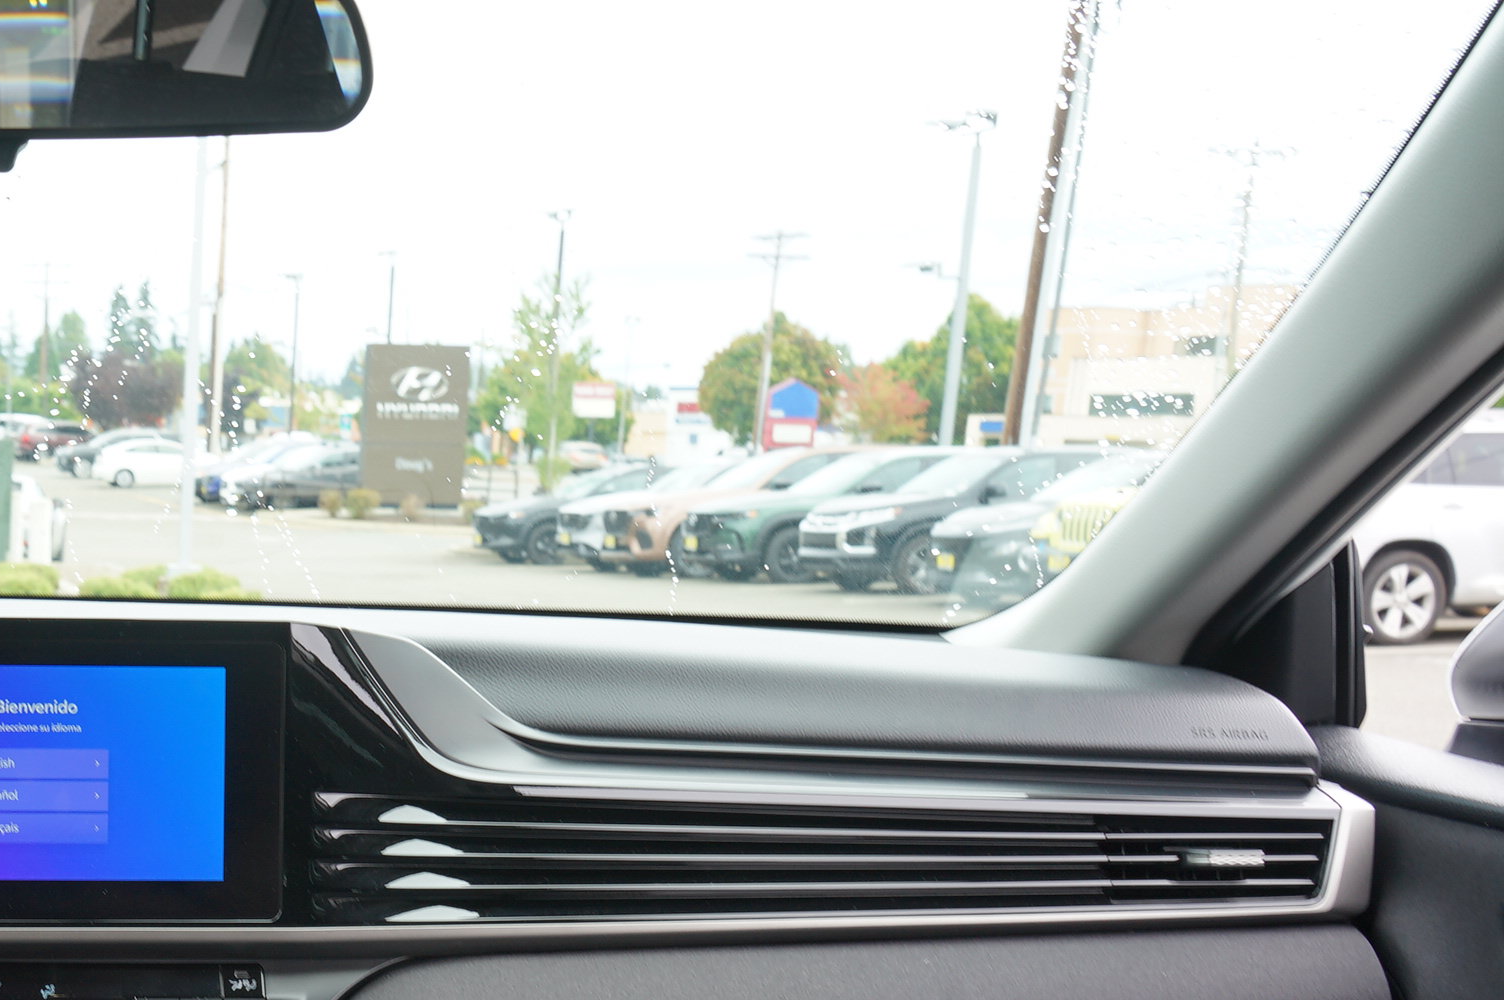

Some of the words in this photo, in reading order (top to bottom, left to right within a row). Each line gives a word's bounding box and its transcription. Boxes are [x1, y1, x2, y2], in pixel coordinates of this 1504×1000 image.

[40, 724, 51, 733] su
[51, 722, 82, 733] idioma
[1221, 728, 1270, 741] AIRBAG
